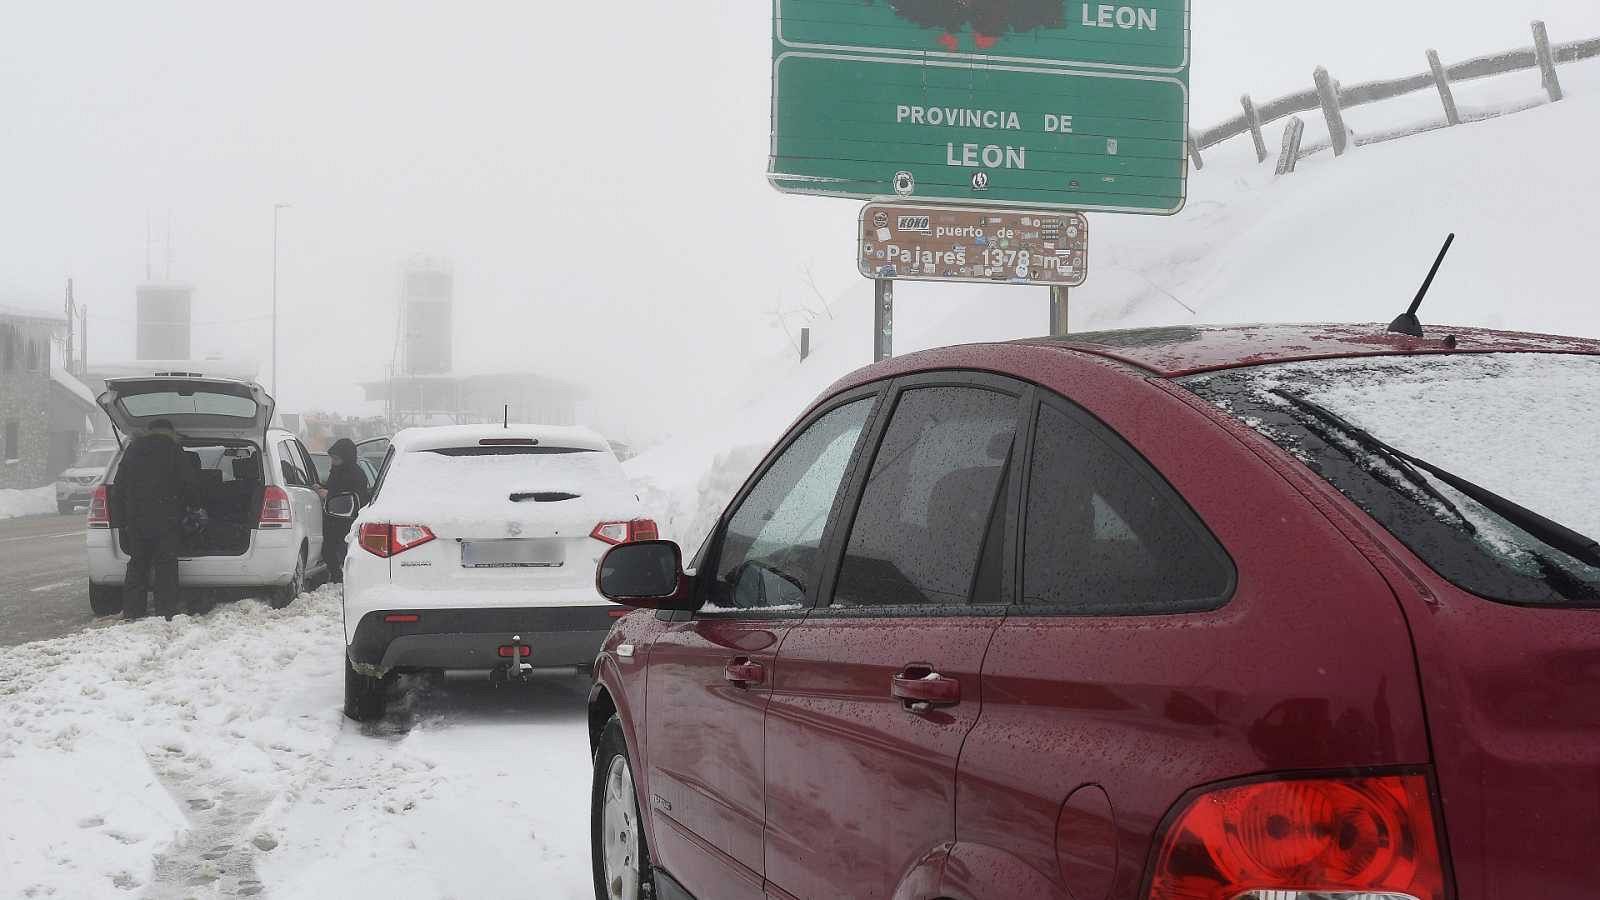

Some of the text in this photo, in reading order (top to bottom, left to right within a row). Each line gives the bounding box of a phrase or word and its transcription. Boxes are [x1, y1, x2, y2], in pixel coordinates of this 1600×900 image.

[1081, 3, 1158, 31] LEON
[896, 105, 1073, 133] PROVINCIA DE
[946, 142, 1026, 170] LEON
[898, 216, 930, 229] KOKO
[936, 226, 983, 238] puerto
[997, 228, 1014, 239] de
[886, 244, 967, 266] Pajares
[981, 250, 1030, 267] 1378
